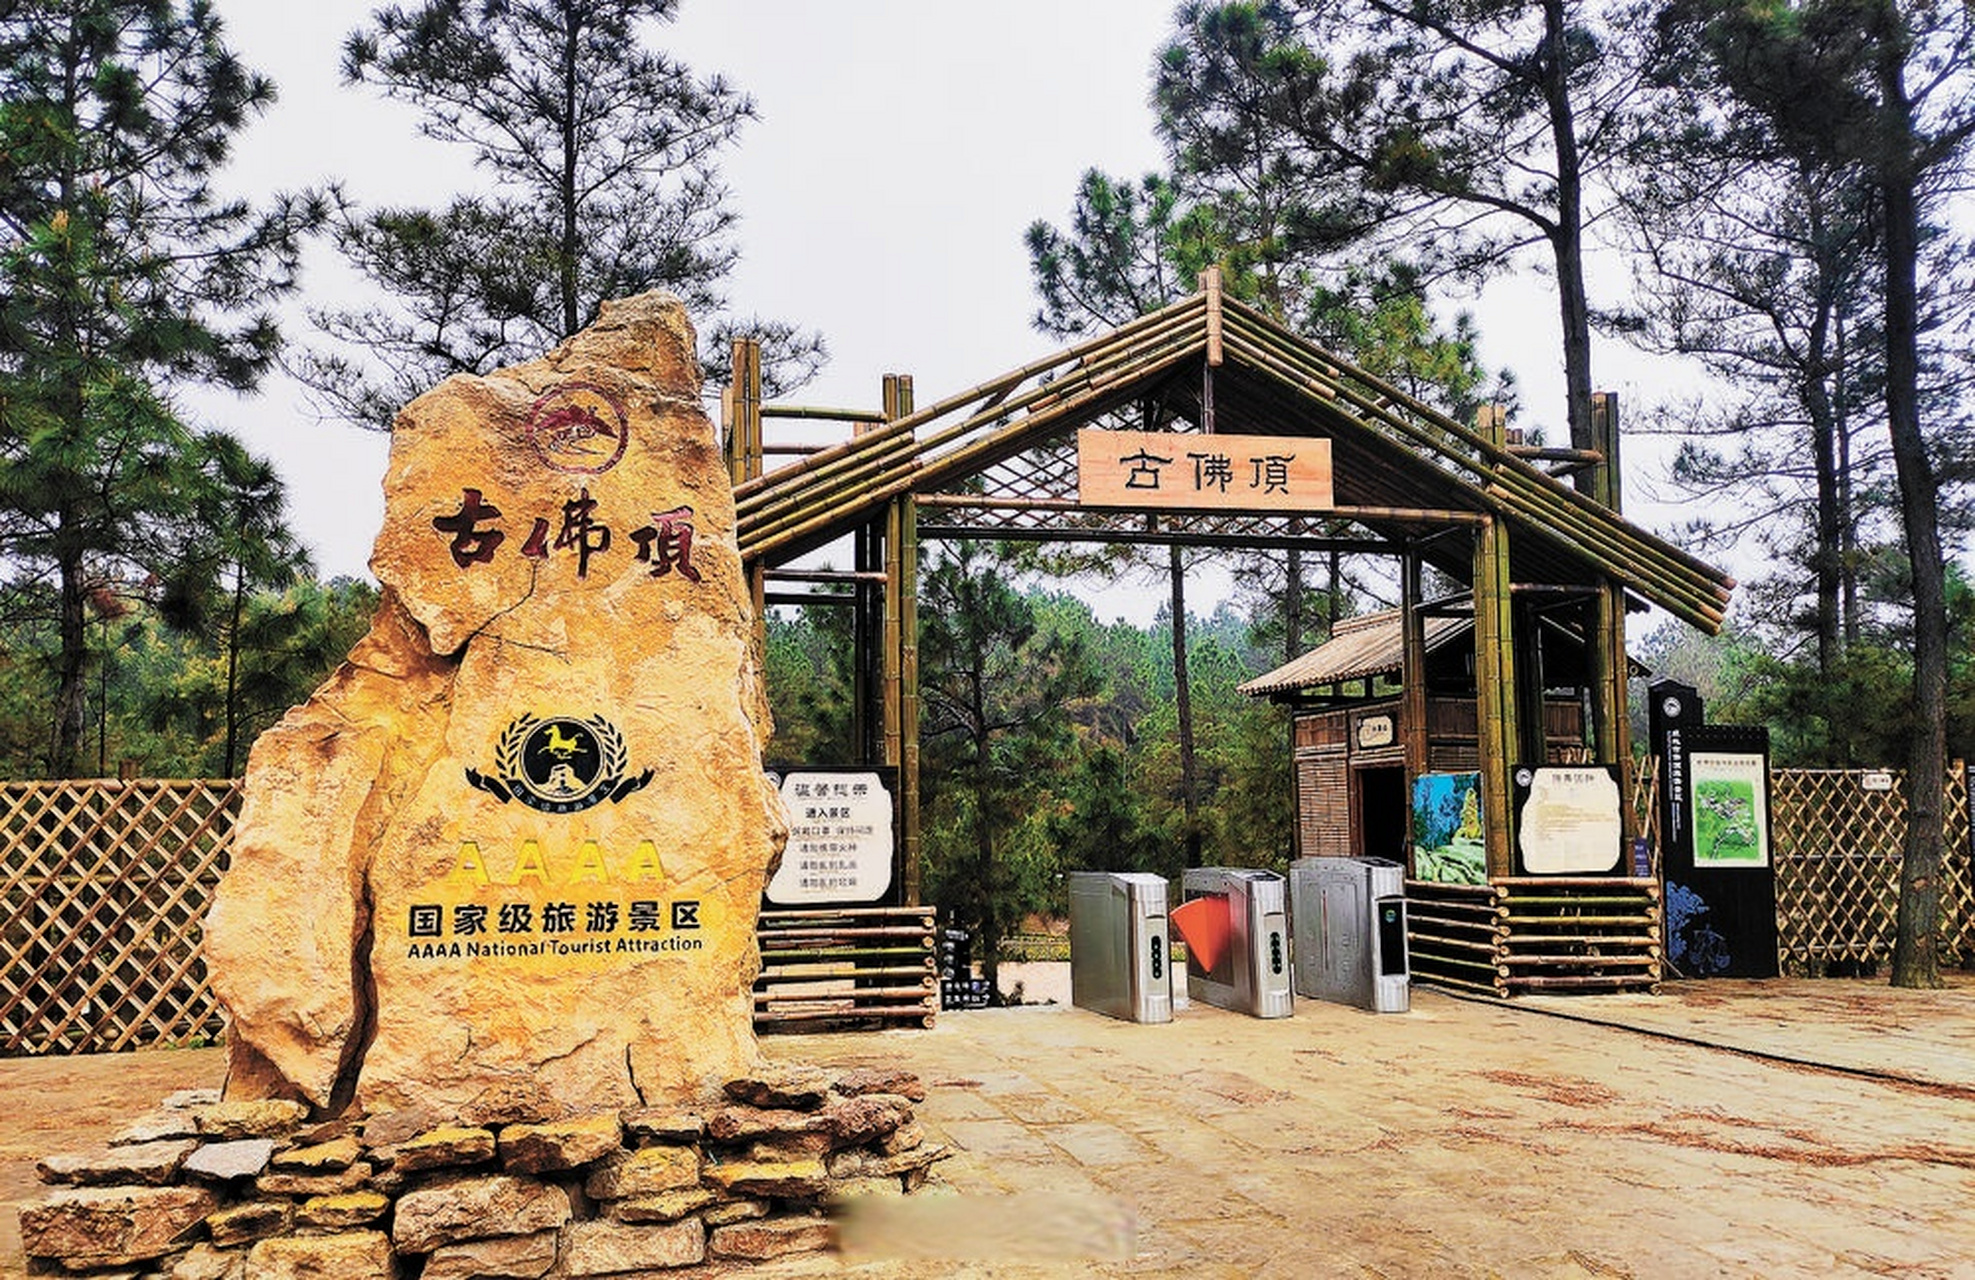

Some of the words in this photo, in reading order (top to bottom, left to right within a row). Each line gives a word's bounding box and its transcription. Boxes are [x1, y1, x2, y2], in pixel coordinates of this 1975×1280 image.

[1119, 448, 1296, 495] 古佛頂
[431, 486, 701, 584] 古佛頂
[408, 901, 701, 937] 国家级旅游景区
[408, 943, 462, 959] AAAA
[467, 940, 545, 957] National
[548, 938, 612, 955] Tourist
[616, 935, 703, 952] Attraction
